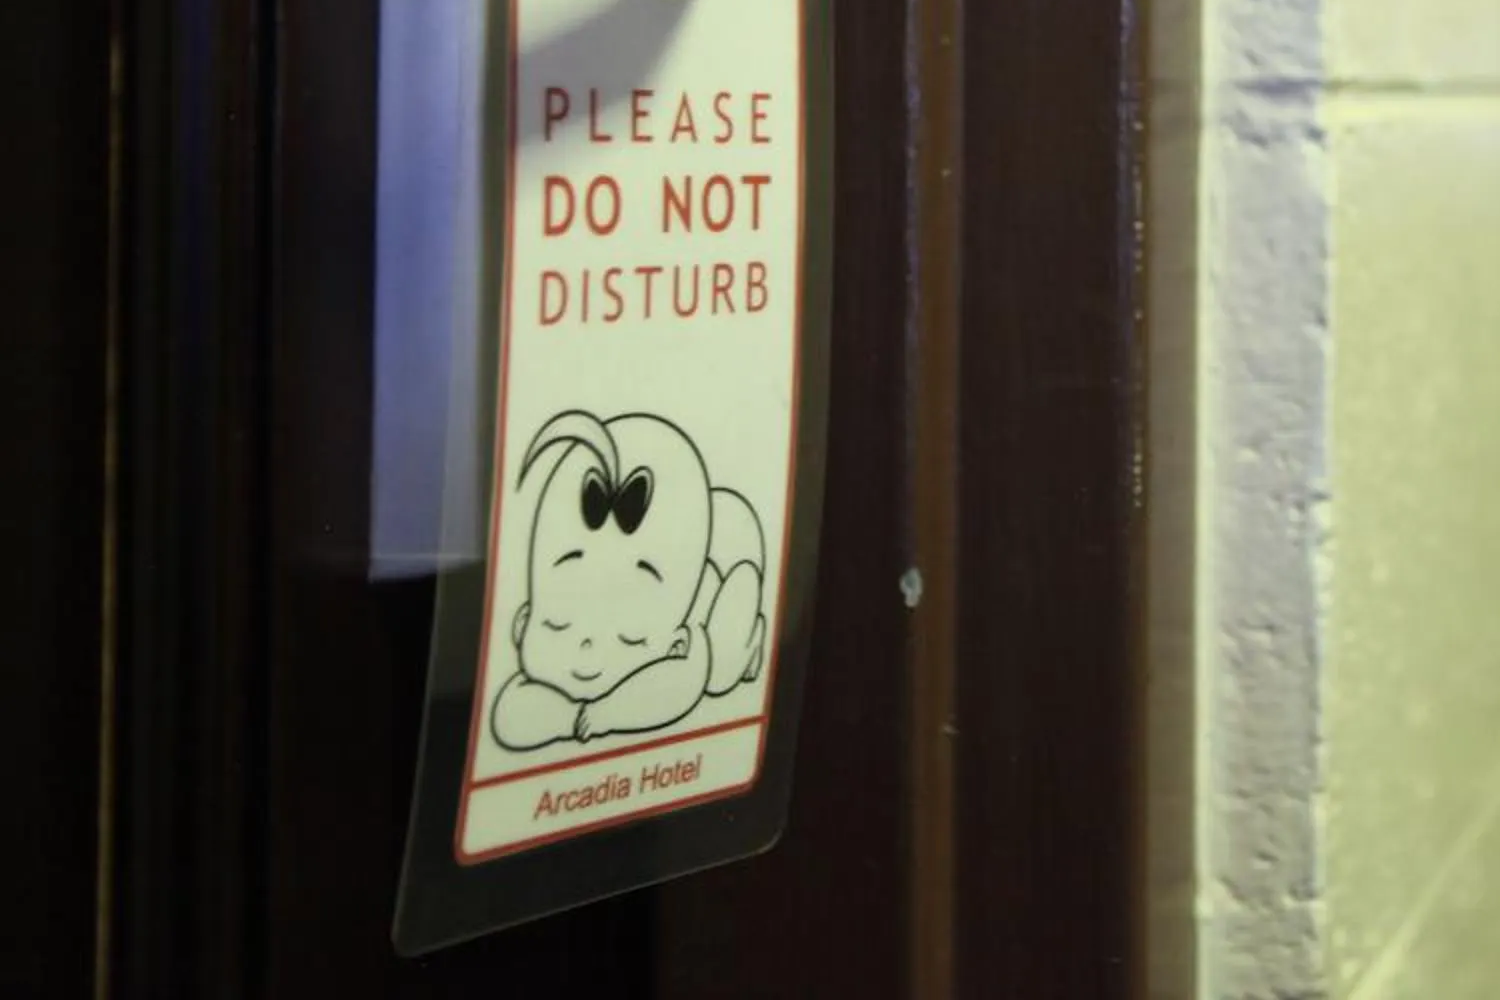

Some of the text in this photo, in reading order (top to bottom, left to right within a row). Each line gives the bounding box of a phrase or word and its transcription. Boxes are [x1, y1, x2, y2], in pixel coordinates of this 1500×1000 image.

[545, 87, 772, 143] PLEASE
[543, 174, 771, 236] DO NOT
[540, 261, 768, 326] DISTURB
[533, 753, 704, 820] Arcadia Hotel
